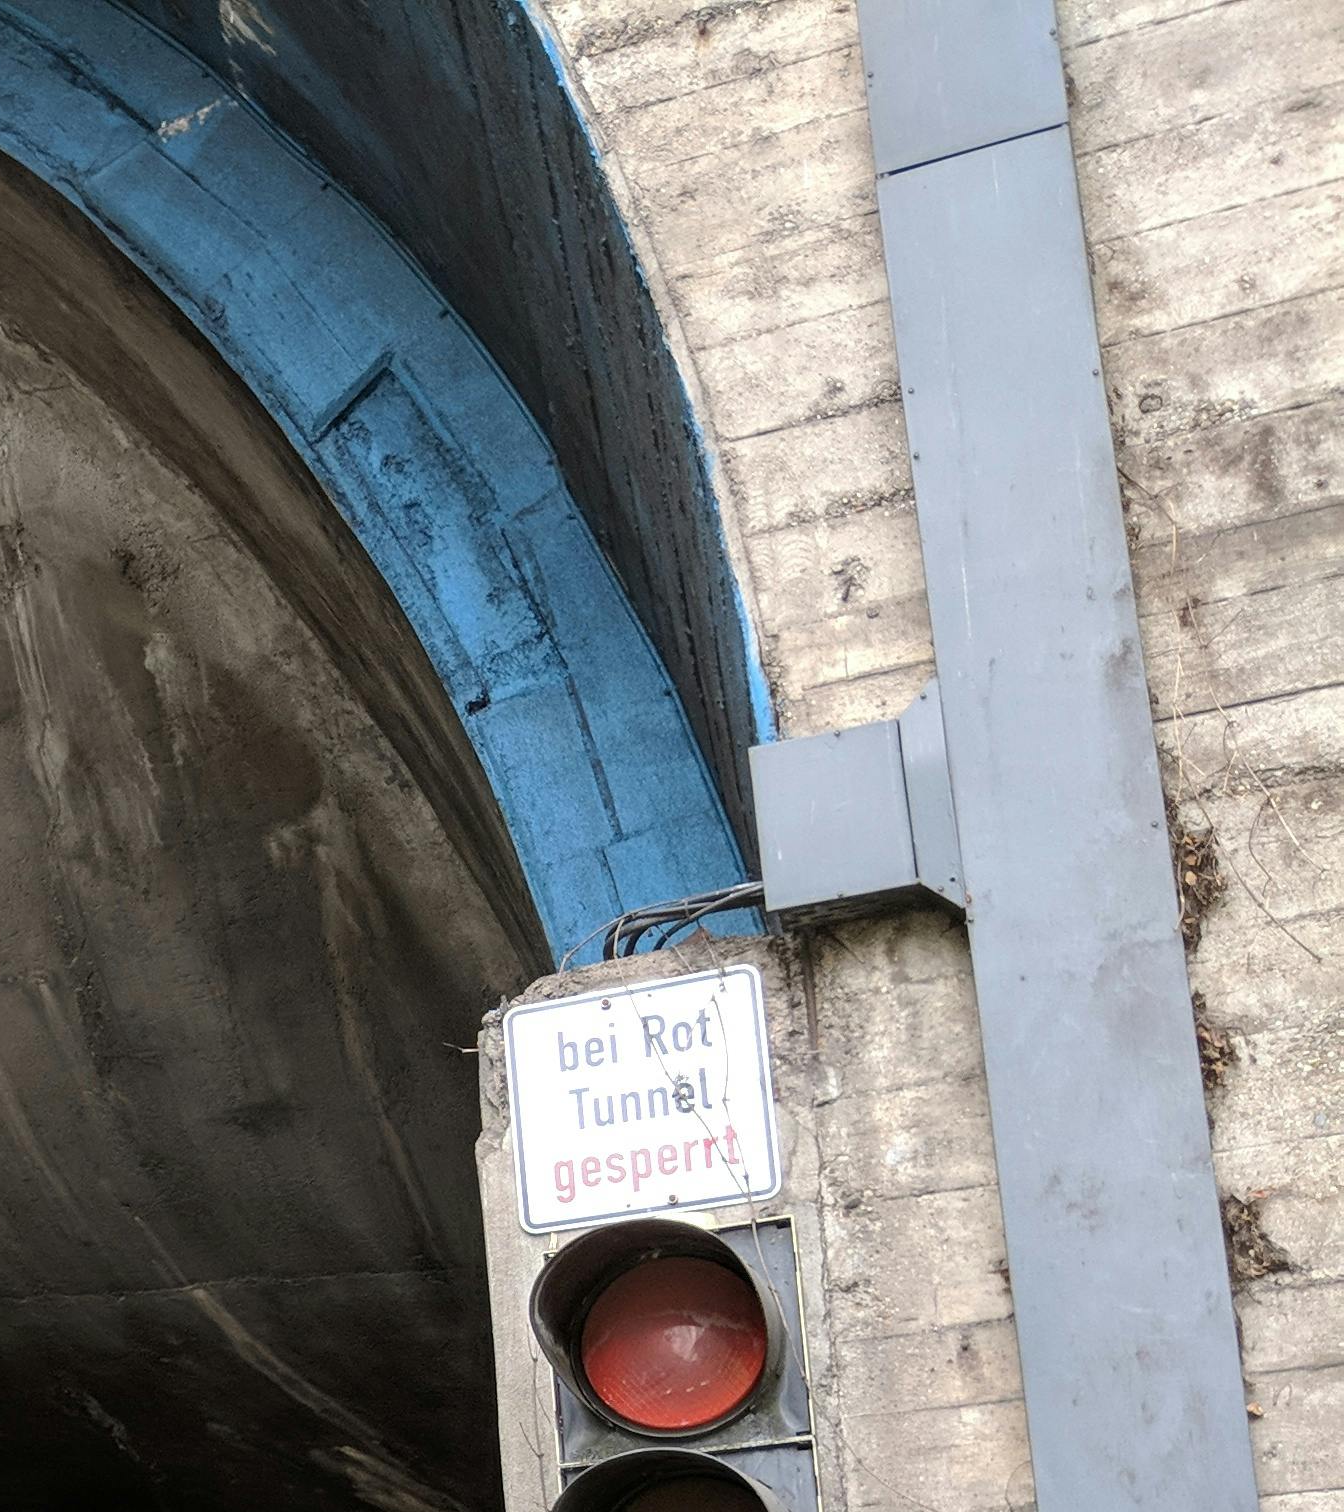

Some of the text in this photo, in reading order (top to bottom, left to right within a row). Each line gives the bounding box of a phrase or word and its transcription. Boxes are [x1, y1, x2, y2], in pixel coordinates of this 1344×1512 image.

[557, 1008, 713, 1072] bei Rot
[569, 1068, 713, 1129] Tunnel
[553, 1125, 740, 1203] gesperrt
